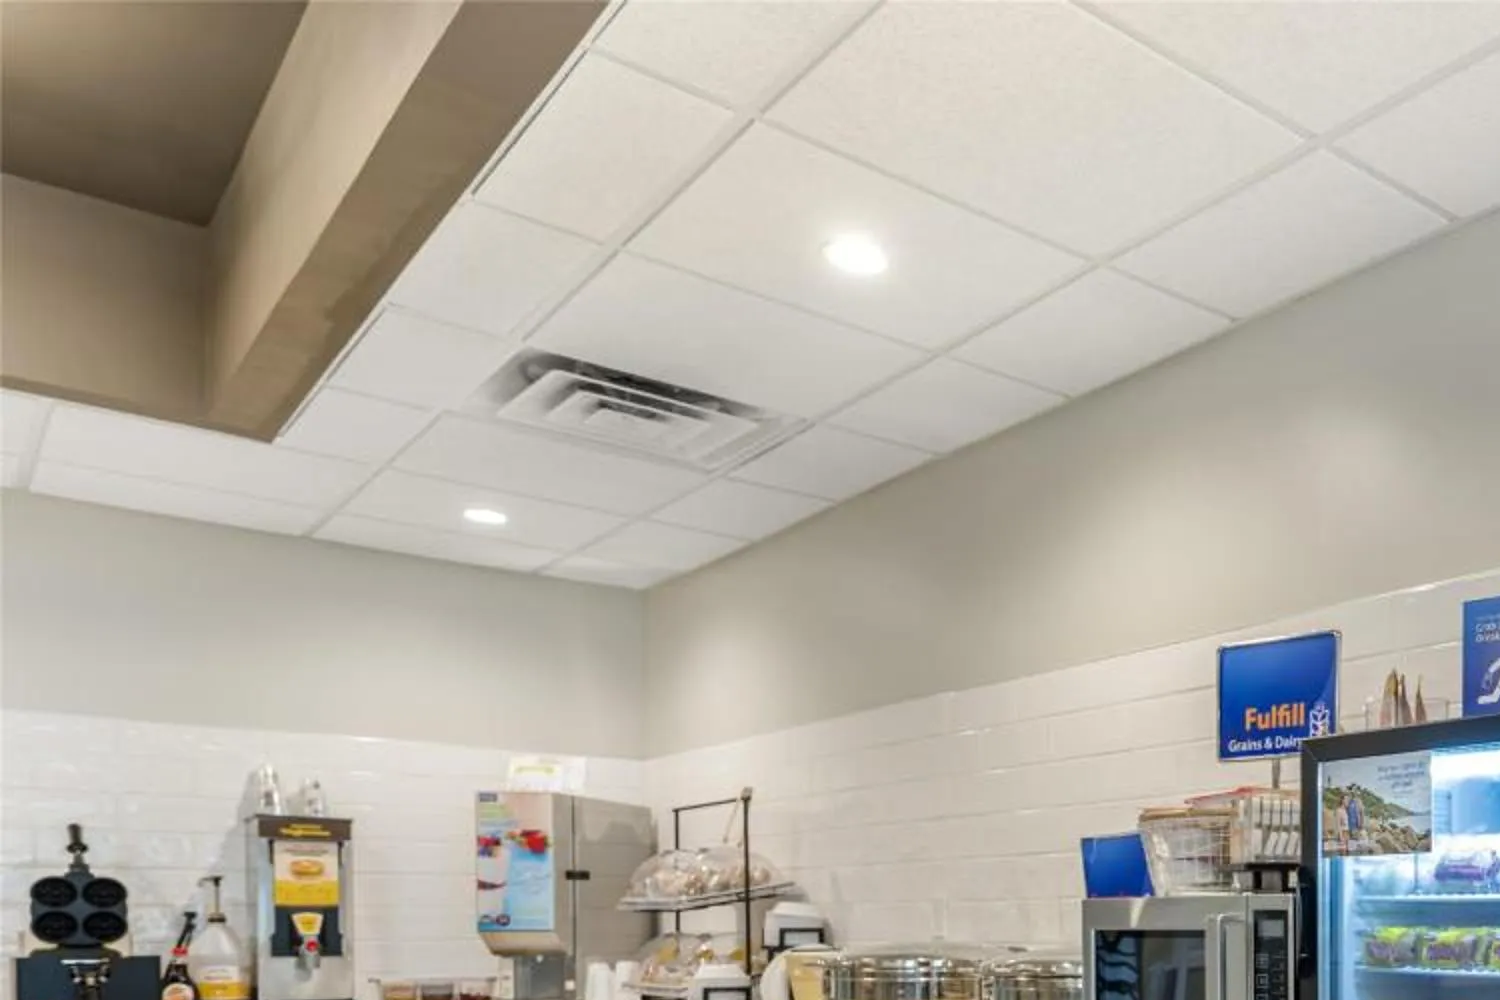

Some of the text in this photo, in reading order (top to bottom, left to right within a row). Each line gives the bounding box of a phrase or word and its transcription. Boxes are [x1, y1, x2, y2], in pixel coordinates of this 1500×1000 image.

[1245, 702, 1305, 732] Fulfill
[1228, 738, 1262, 753] Grains
[1263, 736, 1273, 750] &
